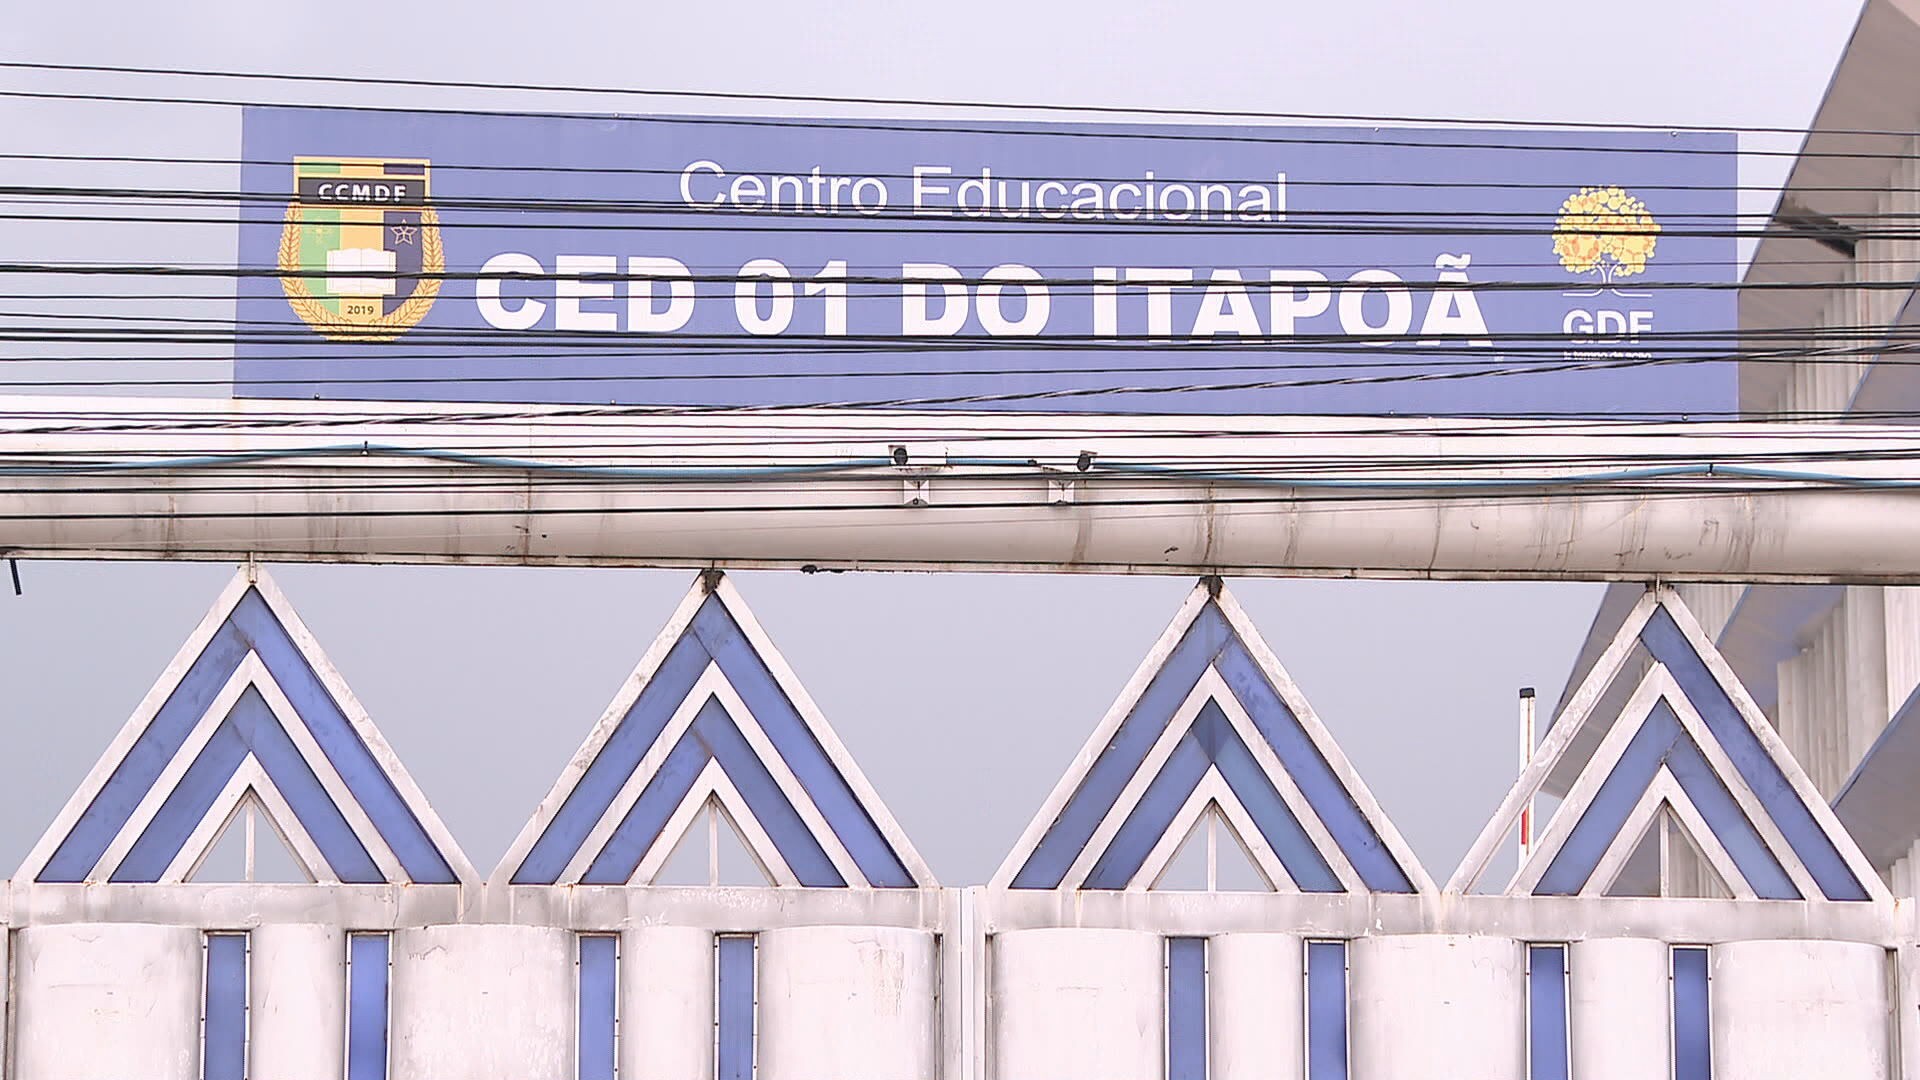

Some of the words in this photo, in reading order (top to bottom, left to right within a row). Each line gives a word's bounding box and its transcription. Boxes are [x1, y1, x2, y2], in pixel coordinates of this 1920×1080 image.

[318, 183, 407, 202] CCMDF
[680, 160, 888, 214] Centro
[912, 166, 1287, 222] Educacional
[347, 305, 374, 315] 2019
[476, 252, 696, 332] CED
[734, 258, 848, 337] 01
[902, 263, 1051, 339] DO
[1093, 253, 1493, 346] ITAPOÃ
[1563, 309, 1653, 343] GDF
